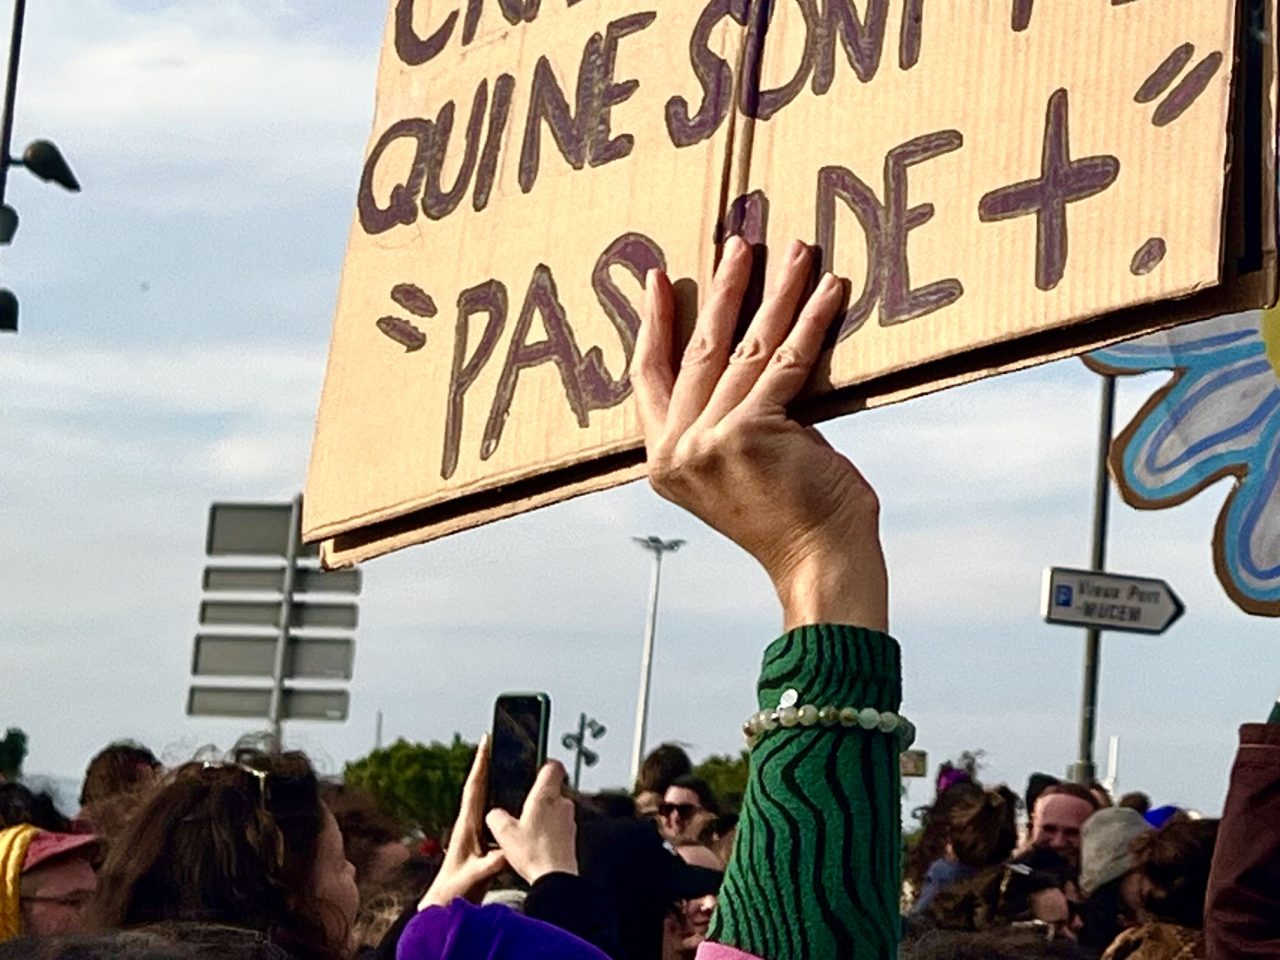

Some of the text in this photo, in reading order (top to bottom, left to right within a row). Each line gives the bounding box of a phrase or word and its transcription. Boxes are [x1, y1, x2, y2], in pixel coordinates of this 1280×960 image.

[357, 73, 513, 235] QUI
[517, 10, 655, 194] NE
[815, 128, 964, 343] DE
[1078, 579, 1161, 604] Vieux Port
